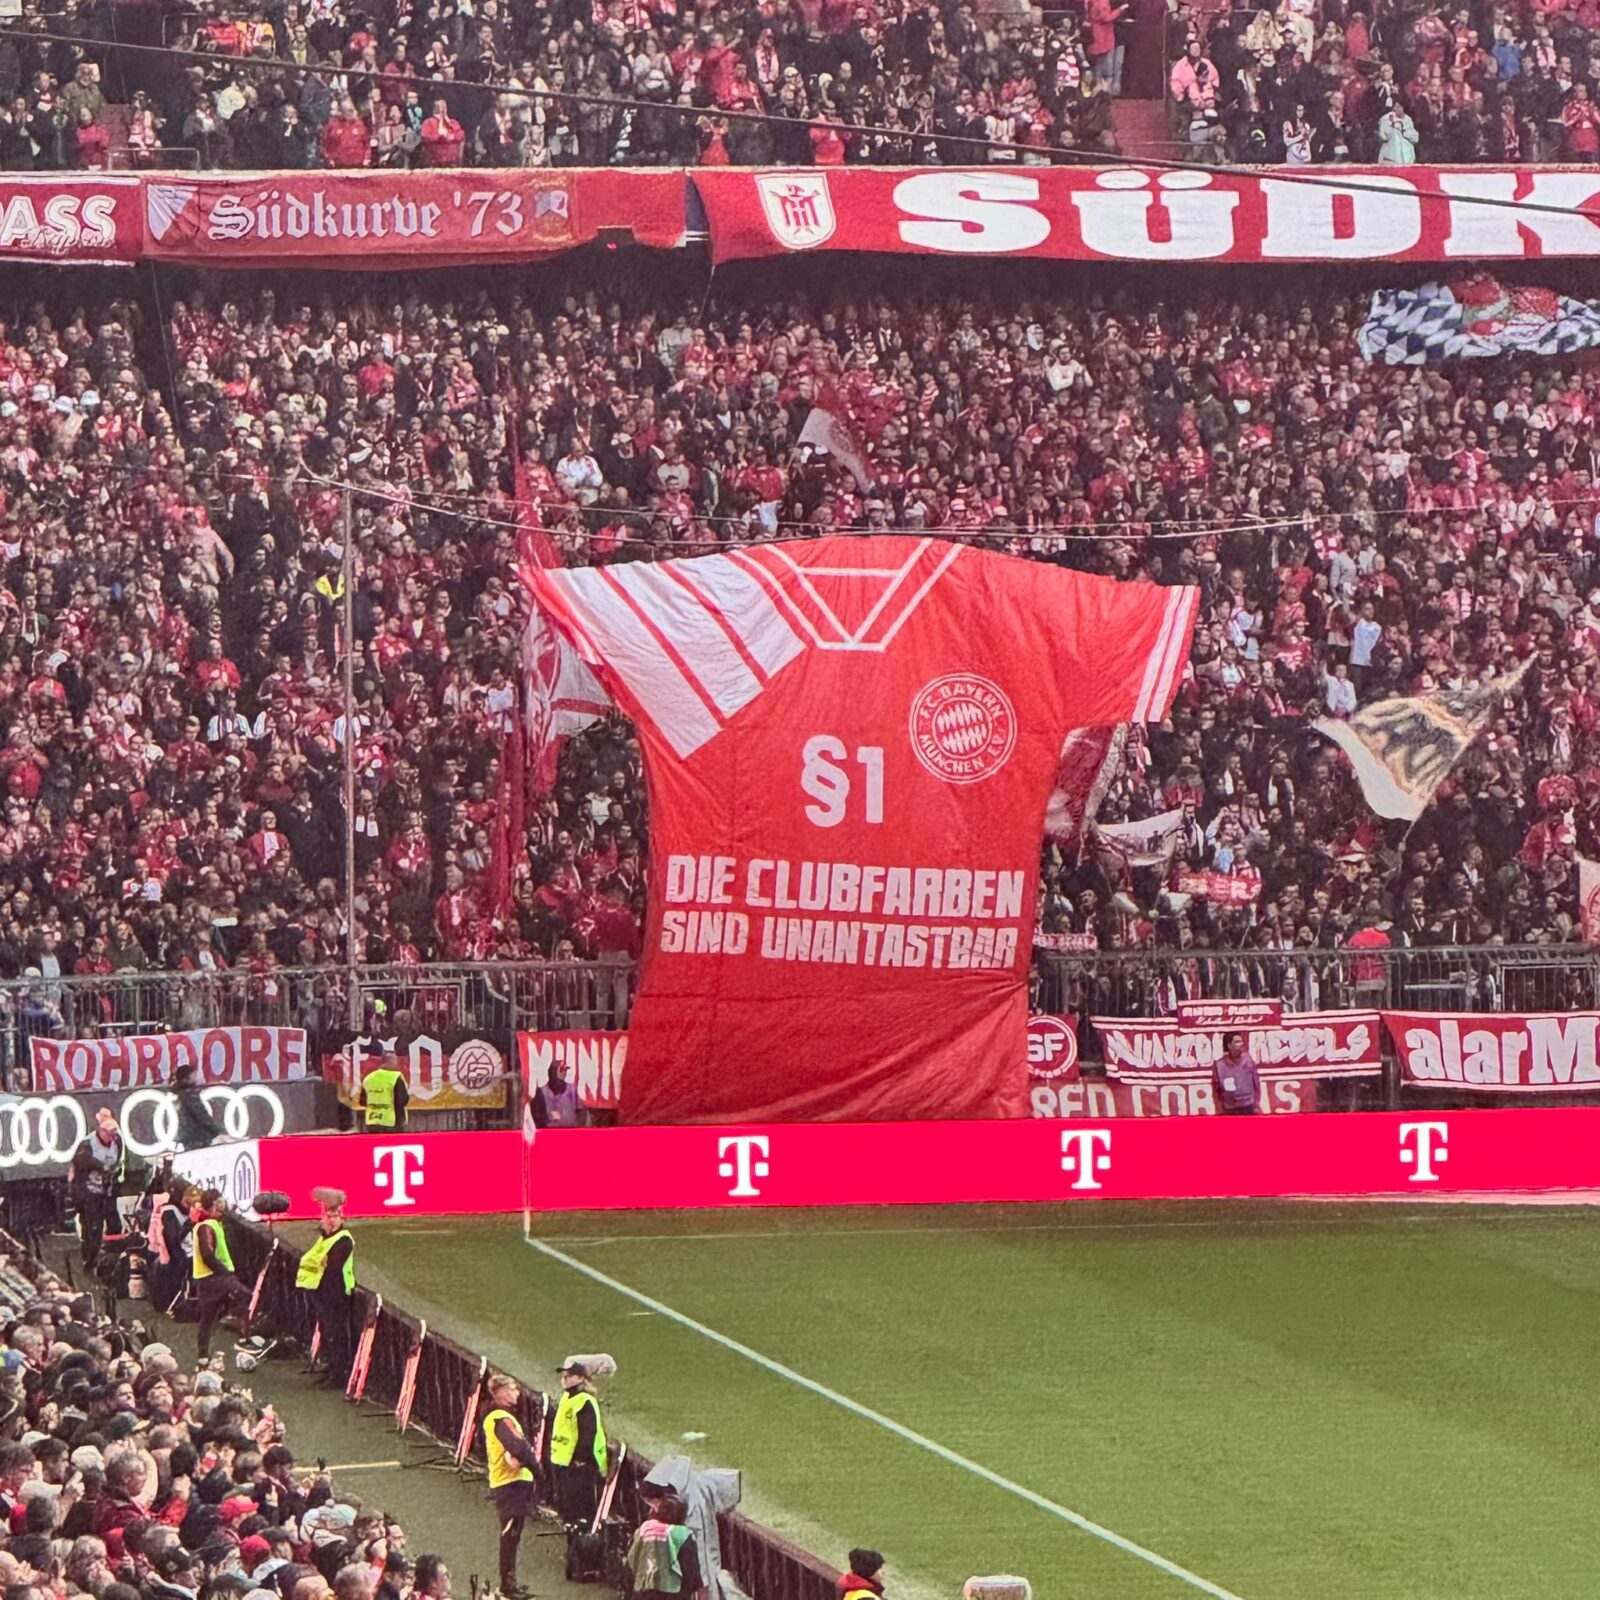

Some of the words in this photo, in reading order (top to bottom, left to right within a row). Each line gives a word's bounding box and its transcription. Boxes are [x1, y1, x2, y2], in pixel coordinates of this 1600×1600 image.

[0, 194, 117, 246] ASS
[208, 190, 441, 240] Südkurve
[453, 191, 523, 236] '73
[939, 683, 1005, 719] BAYERN
[665, 855, 736, 904] DIE
[745, 858, 1025, 918] CLUBFARBEN
[660, 910, 750, 954] SIND
[761, 916, 1018, 969] UNANTASTBAR
[31, 1028, 304, 1092] ROHRDORF
[1249, 1024, 1371, 1064] REBELS
